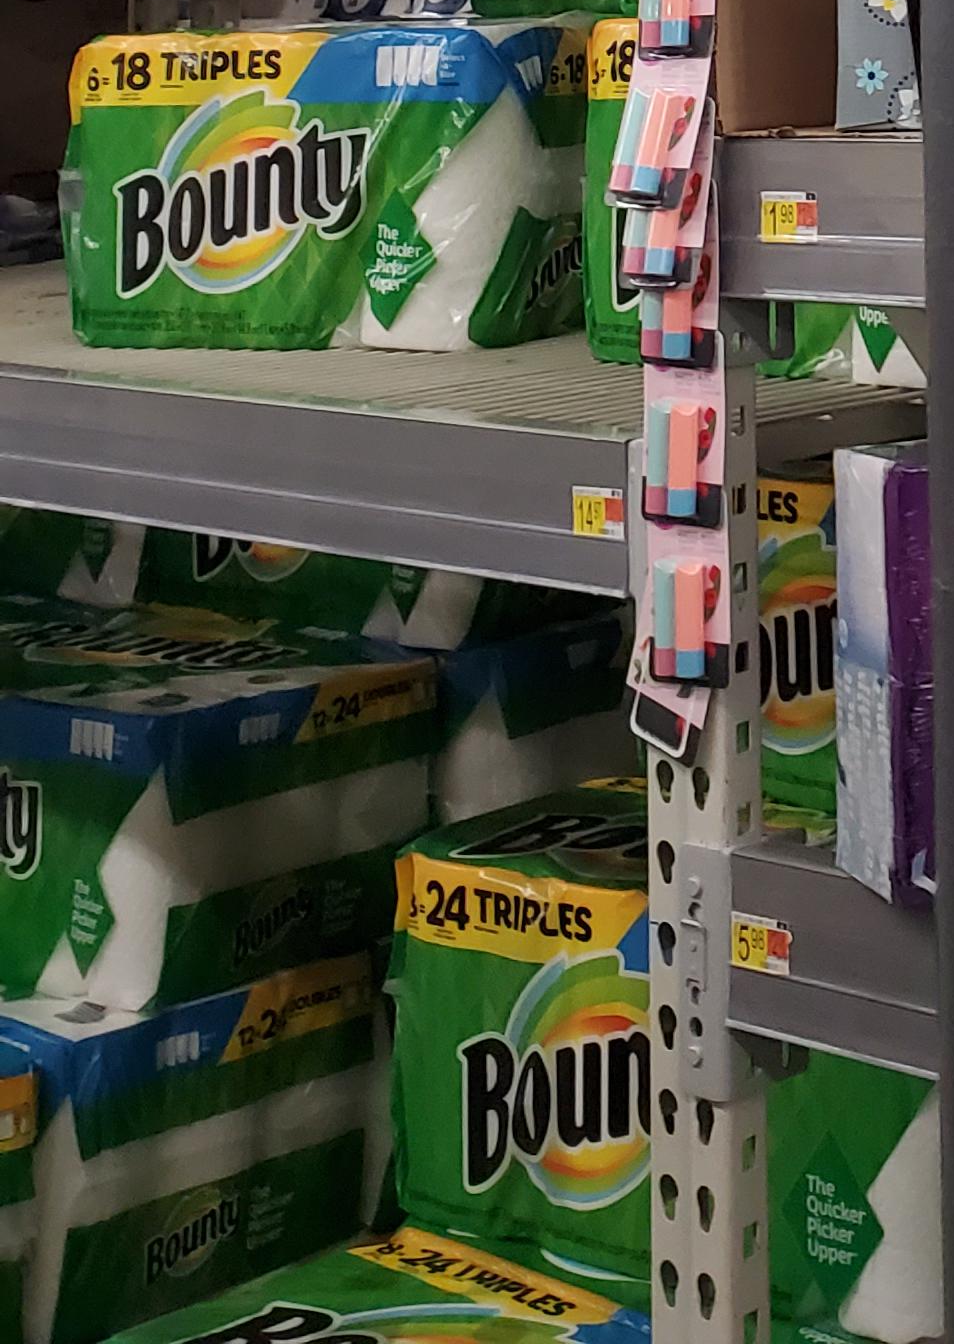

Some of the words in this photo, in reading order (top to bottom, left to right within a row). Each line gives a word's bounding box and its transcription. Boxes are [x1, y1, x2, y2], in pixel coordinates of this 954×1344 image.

[160, 49, 281, 82] TRIPLES
[118, 122, 367, 294] Bounty
[377, 223, 399, 241] The
[376, 240, 423, 259] Quicker
[473, 887, 593, 943] TRIPLES
[806, 1173, 835, 1196] The
[806, 1194, 866, 1225] Quicker
[147, 1194, 241, 1287] Bounty
[807, 1215, 854, 1245] Picker
[807, 1237, 857, 1265] Upper
[453, 1263, 575, 1316] TRIPLES
